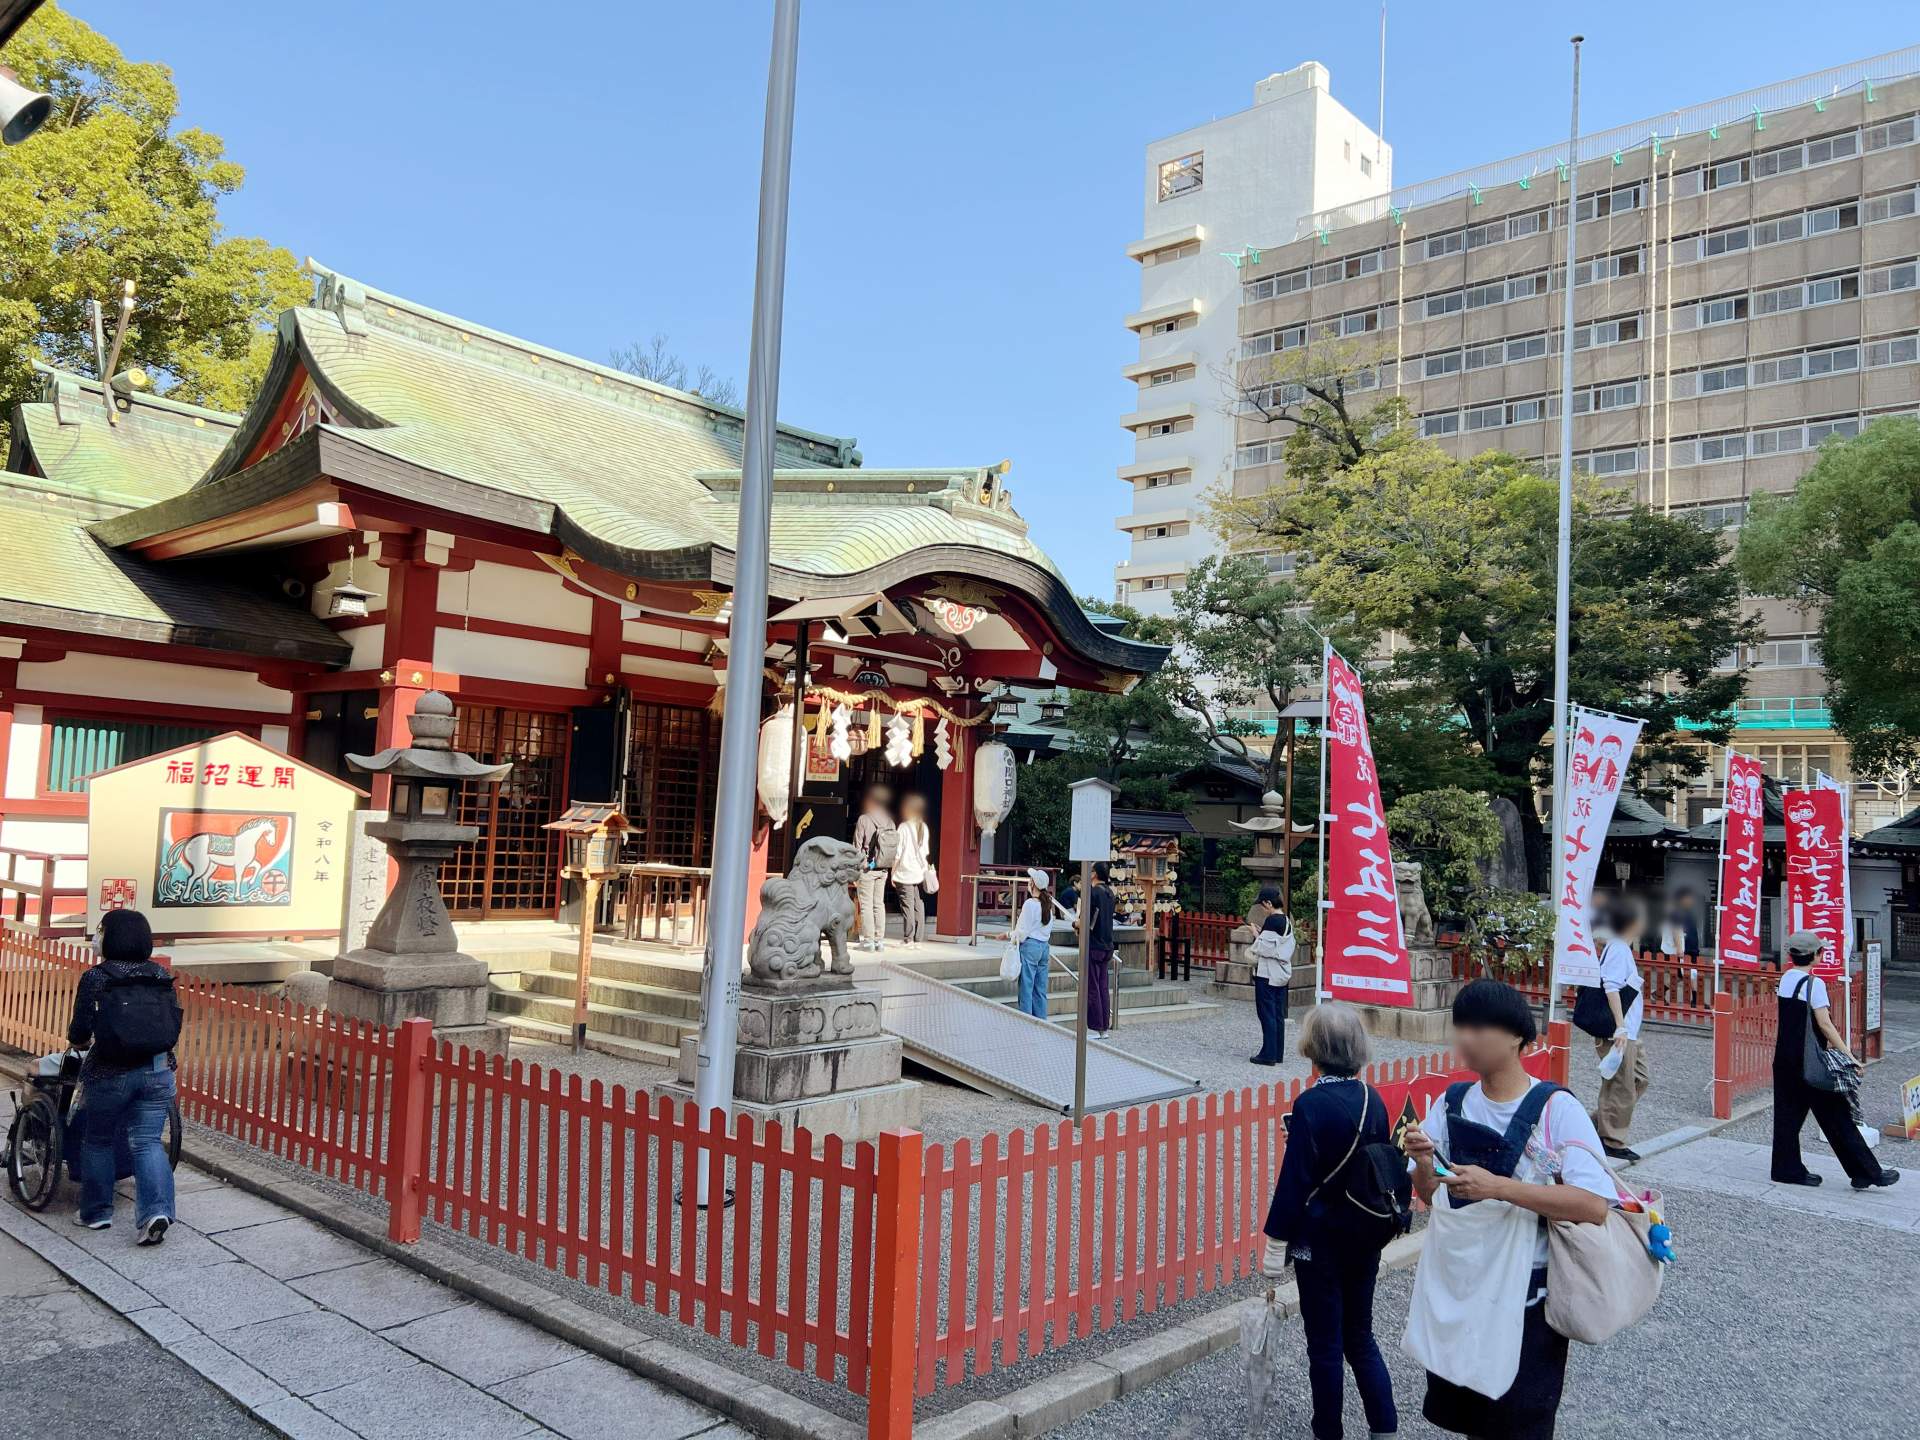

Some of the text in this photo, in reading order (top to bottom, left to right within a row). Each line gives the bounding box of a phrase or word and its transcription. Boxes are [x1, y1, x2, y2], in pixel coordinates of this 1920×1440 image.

[313, 820, 333, 882] 令和八年
[263, 873, 286, 895] 午
